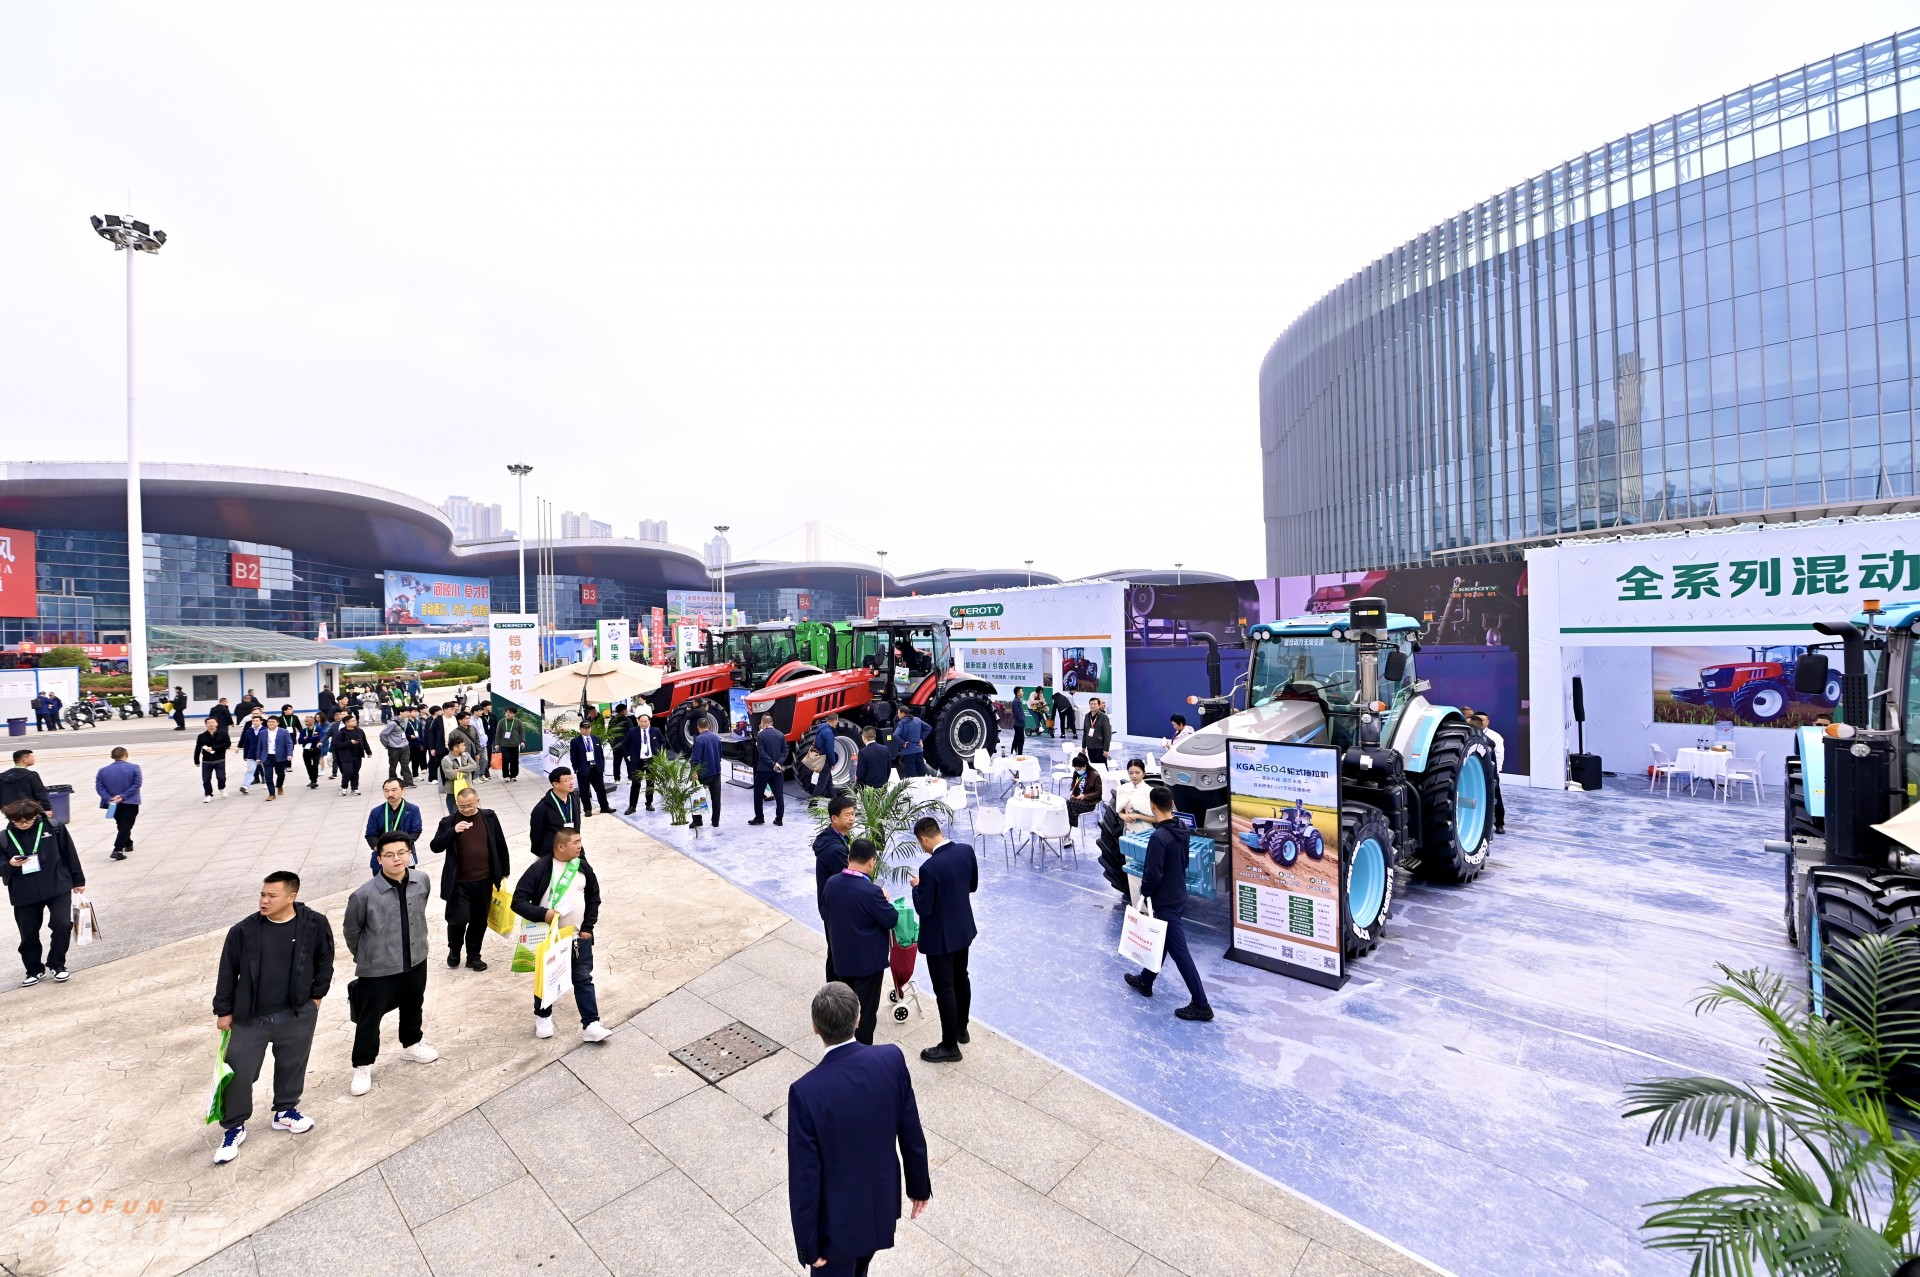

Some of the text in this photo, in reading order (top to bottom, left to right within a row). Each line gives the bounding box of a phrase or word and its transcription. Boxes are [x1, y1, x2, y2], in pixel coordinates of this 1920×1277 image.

[235, 562, 258, 580] B2
[1616, 549, 1920, 601] 全系列混动
[583, 589, 596, 600] B3
[800, 597, 810, 606] B4
[508, 635, 523, 691] 铠特农机
